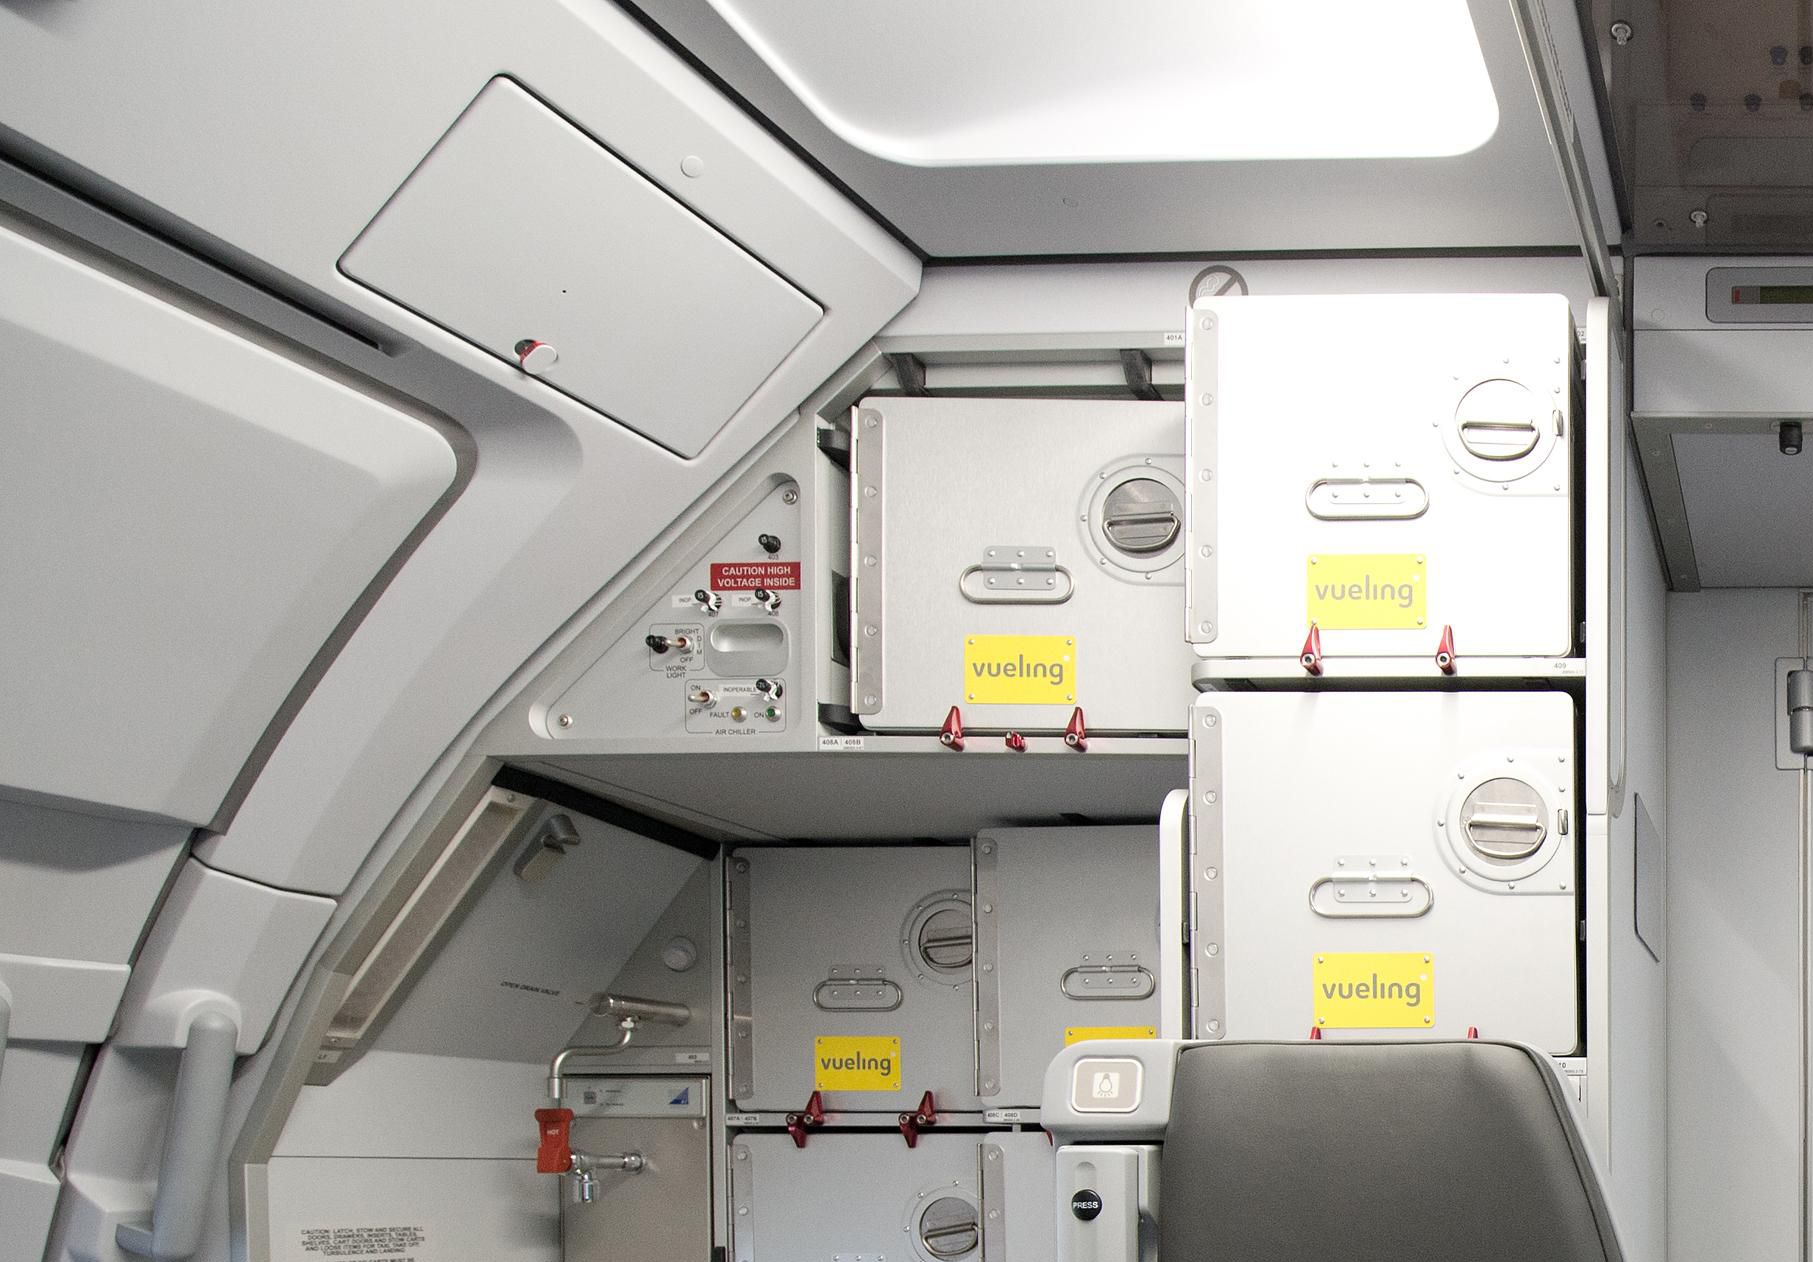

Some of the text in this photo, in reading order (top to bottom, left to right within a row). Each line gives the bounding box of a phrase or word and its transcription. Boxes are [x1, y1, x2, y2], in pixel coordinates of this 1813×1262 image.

[718, 578, 796, 587] VOLTAGE INSIDE
[722, 566, 791, 576] CAUTION HIGH
[1316, 576, 1415, 609] vueling
[972, 655, 1064, 686] vueling
[1322, 973, 1421, 1007] vueling
[821, 1050, 892, 1076] vueling
